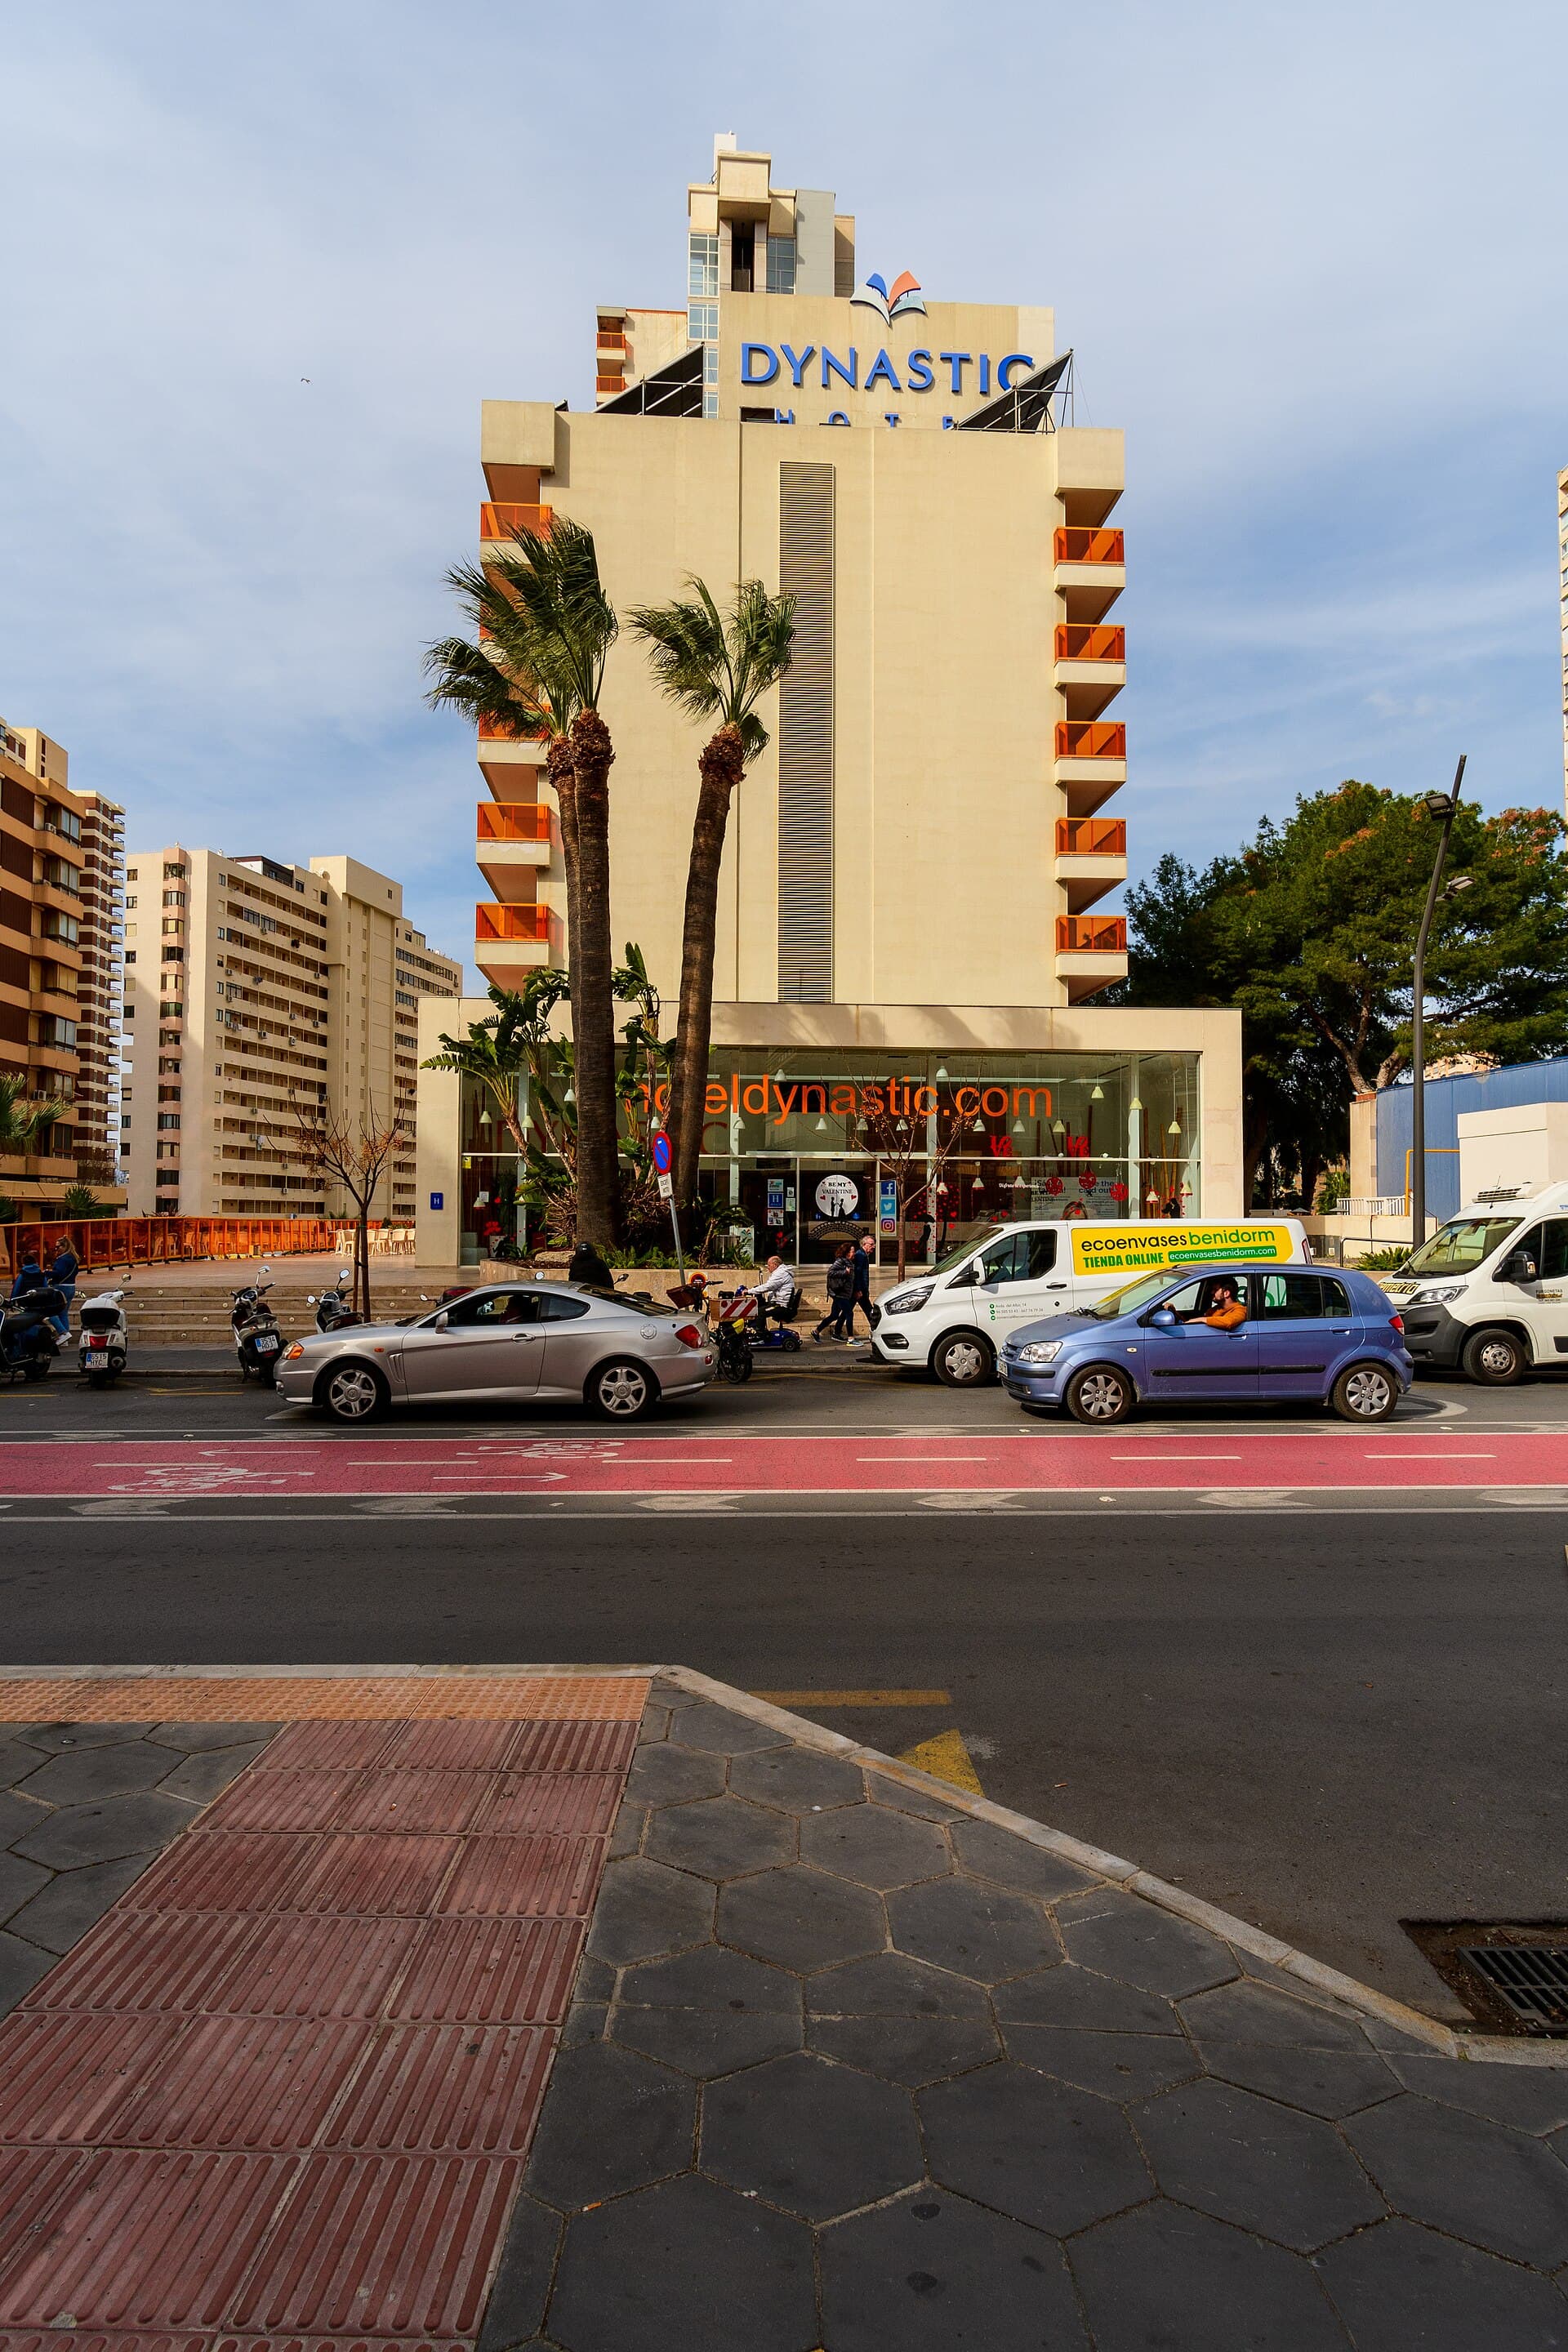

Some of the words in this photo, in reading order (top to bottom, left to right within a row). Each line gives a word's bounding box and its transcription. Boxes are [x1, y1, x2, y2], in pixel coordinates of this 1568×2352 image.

[741, 342, 1034, 394] DYNASTIC
[776, 408, 953, 430] HOTE
[773, 1195, 779, 1203] H
[1081, 1234, 1187, 1251] ecoenvases
[1189, 1229, 1275, 1245] benidorm
[1083, 1254, 1123, 1267] TIENDA
[1125, 1253, 1163, 1266] ONLINE
[1169, 1247, 1276, 1260] ecoenvasesbenidorm.com
